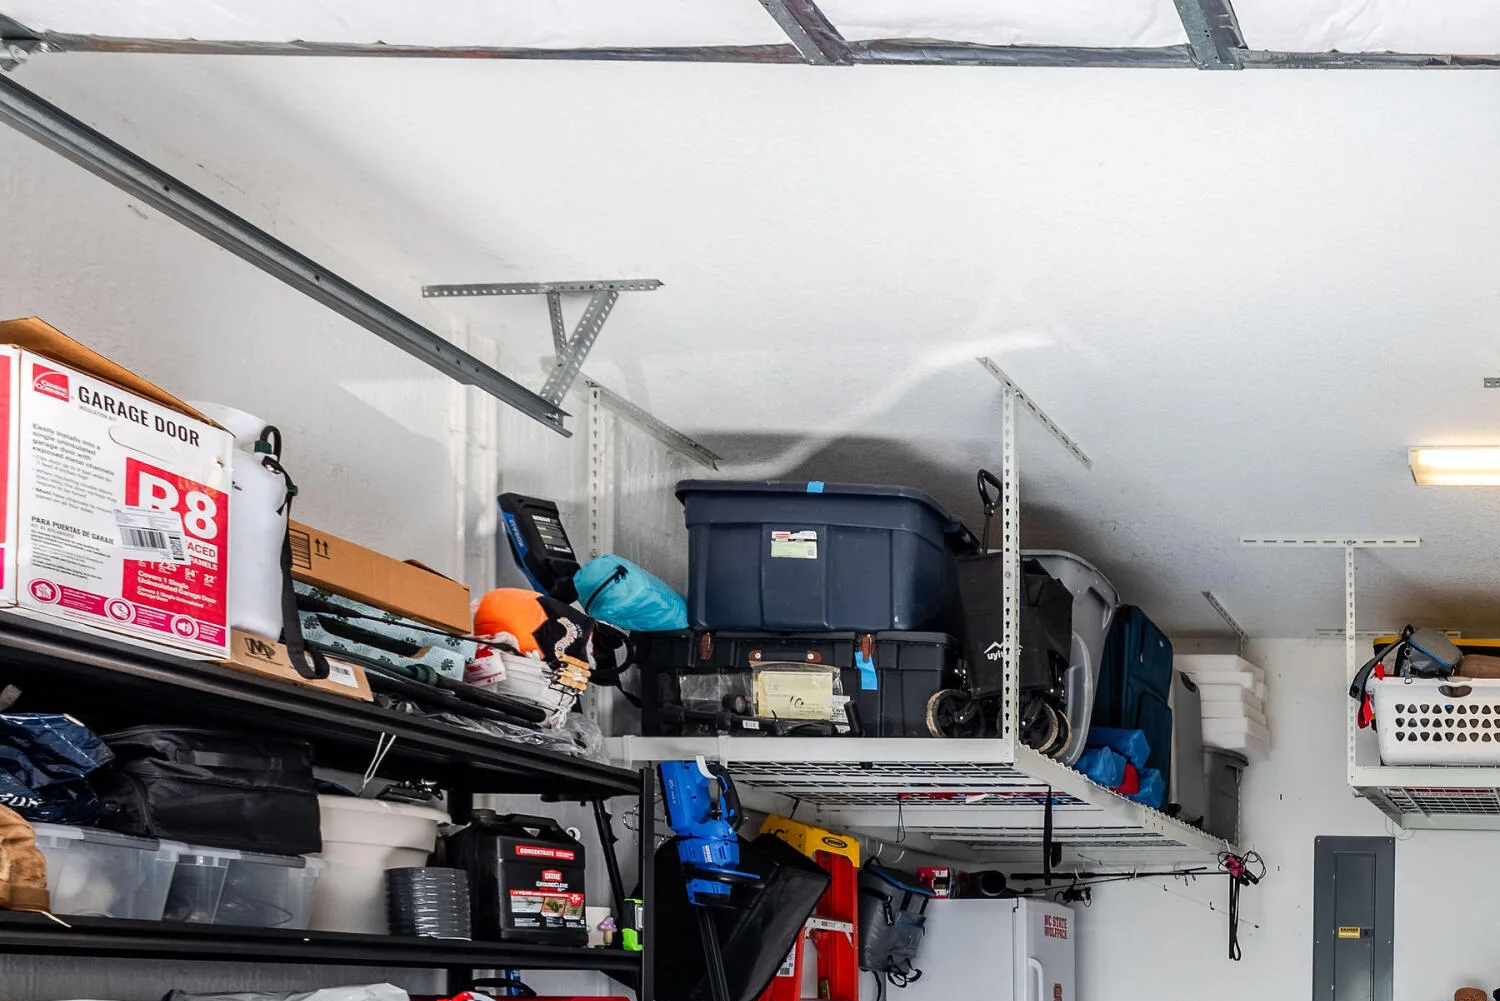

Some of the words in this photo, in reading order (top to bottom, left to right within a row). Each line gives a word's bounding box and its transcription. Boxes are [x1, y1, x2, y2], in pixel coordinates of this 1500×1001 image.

[78, 386, 150, 427] GARAGE
[154, 416, 200, 447] DOOR
[186, 542, 216, 558] ACED
